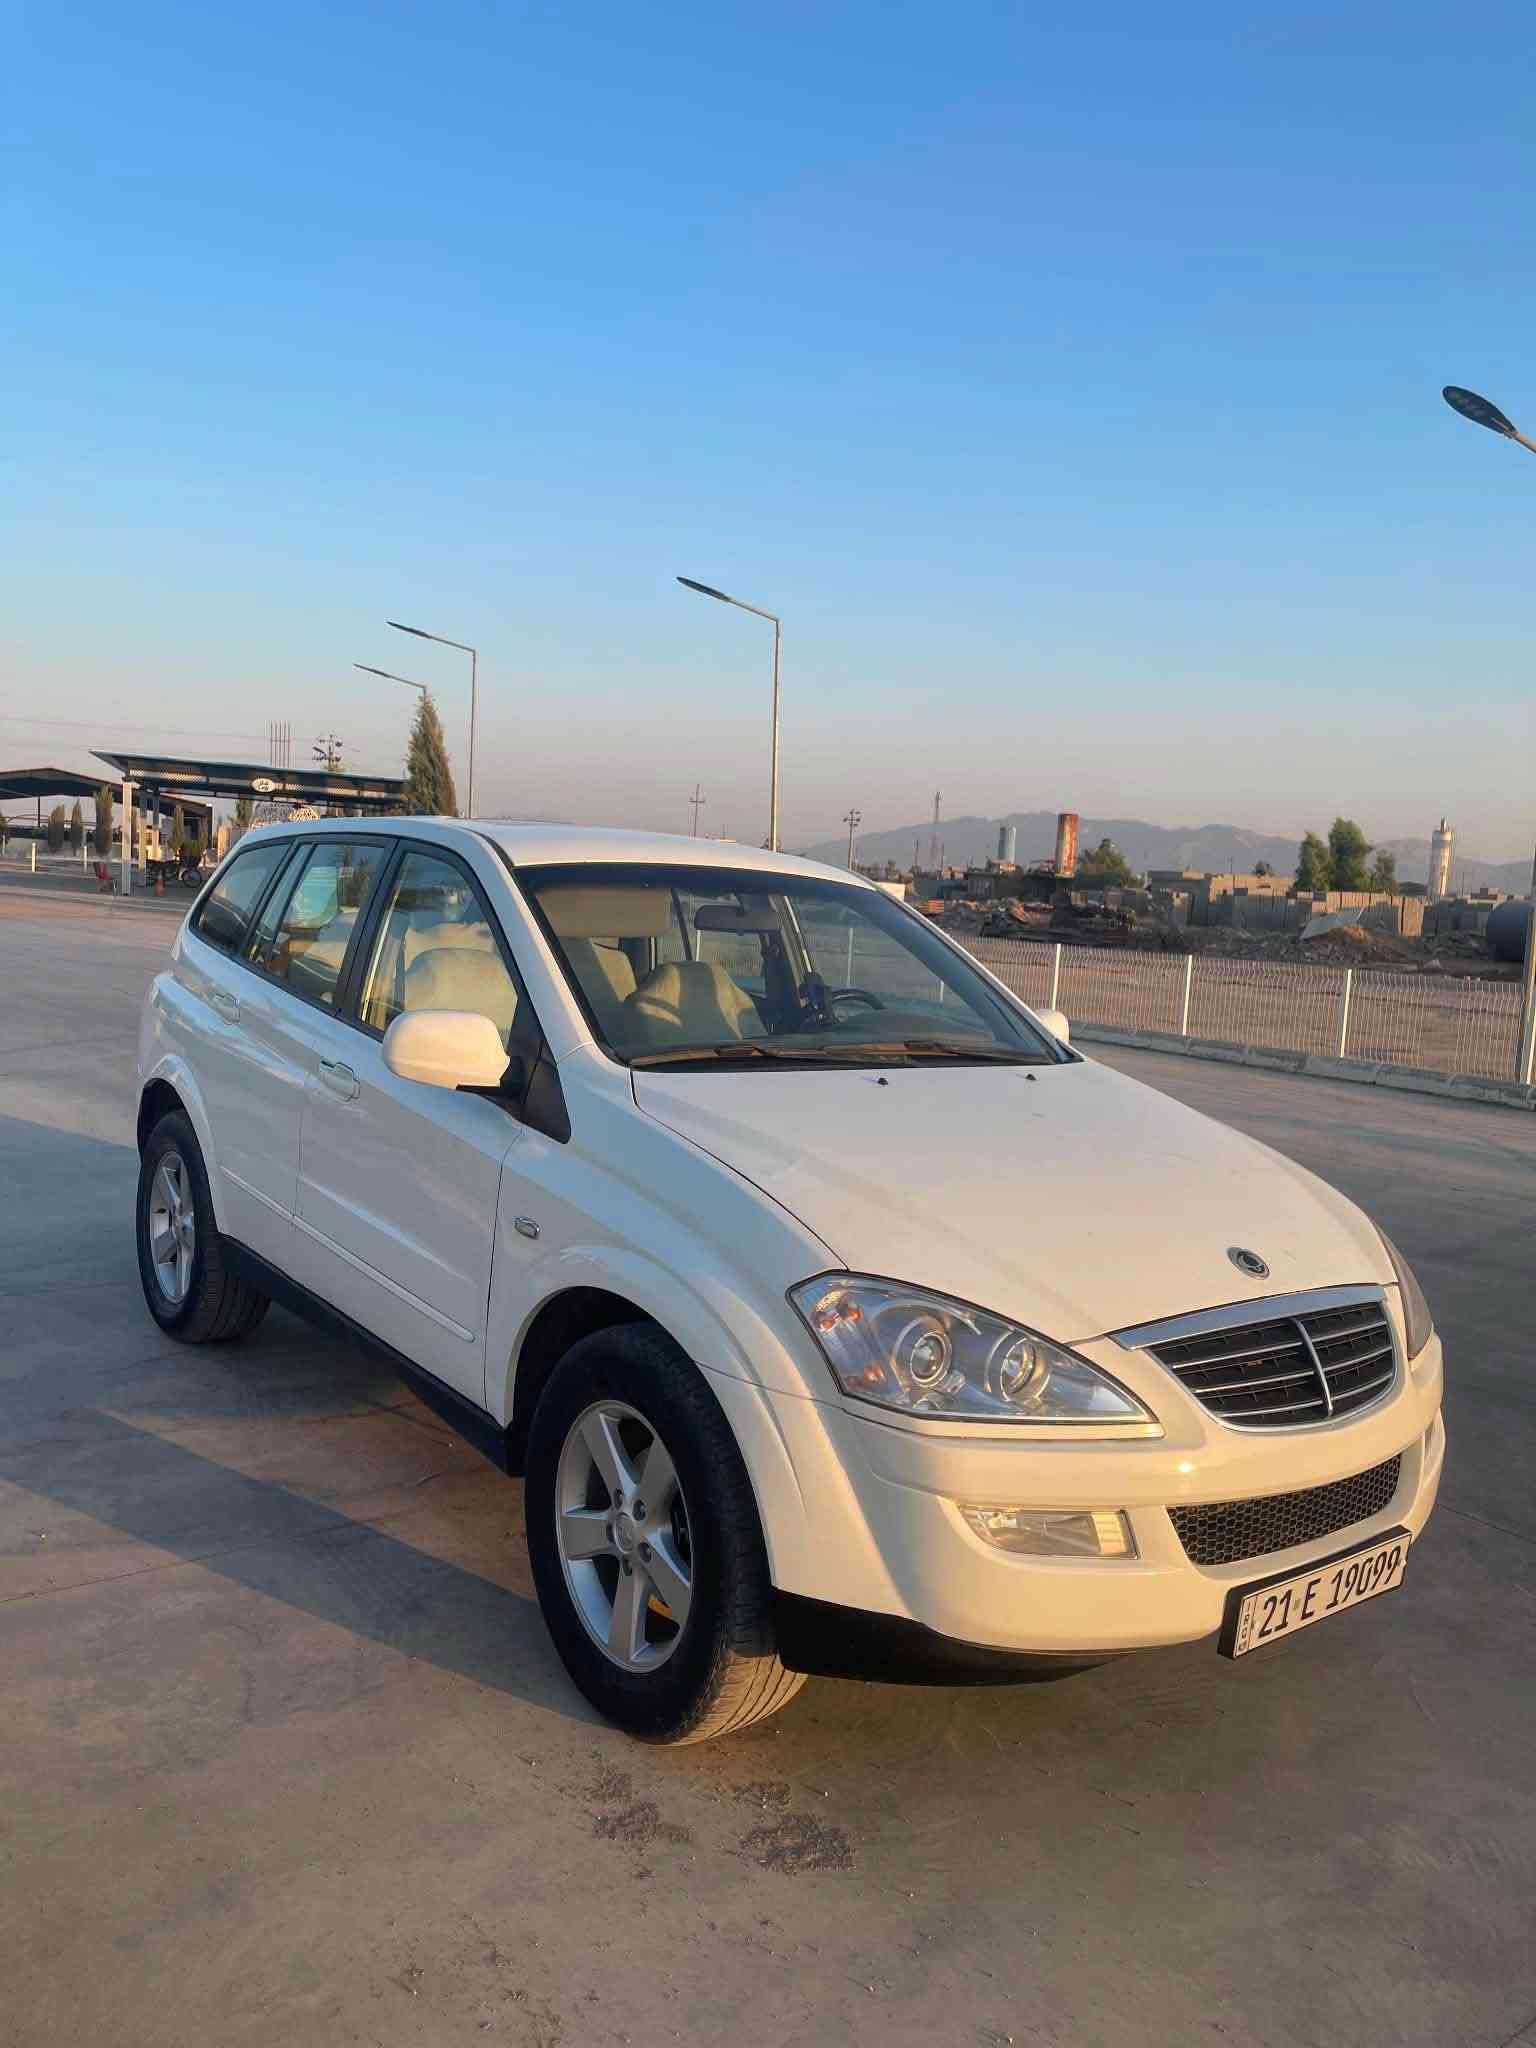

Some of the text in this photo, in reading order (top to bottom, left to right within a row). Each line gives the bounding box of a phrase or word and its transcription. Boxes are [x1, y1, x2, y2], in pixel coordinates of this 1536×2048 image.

[1258, 1545, 1401, 1638] 21 E 19099
